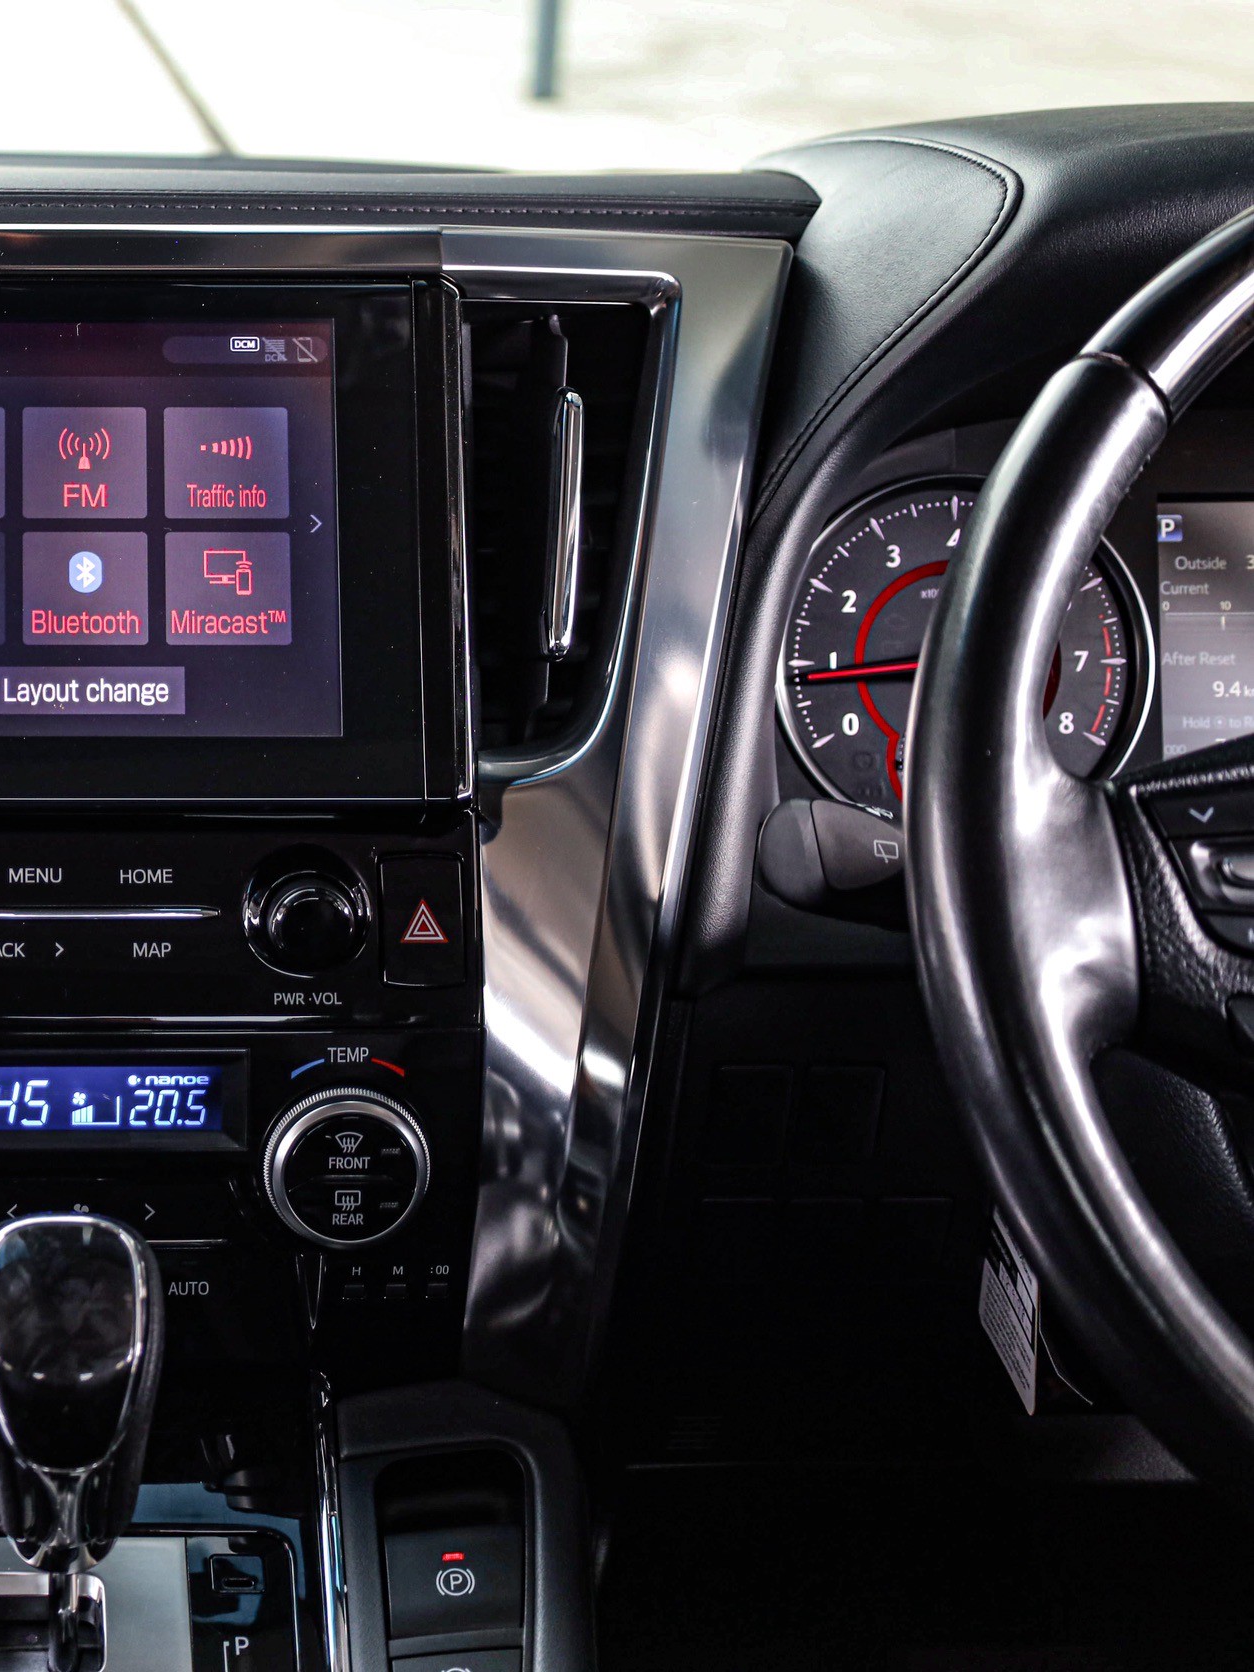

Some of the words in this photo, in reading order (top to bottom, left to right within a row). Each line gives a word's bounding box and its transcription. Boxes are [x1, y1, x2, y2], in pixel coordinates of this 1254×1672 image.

[234, 340, 256, 349] DCM
[63, 484, 108, 507] FM
[187, 484, 235, 507] Traffic
[239, 484, 267, 507] info
[1160, 518, 1176, 539] P
[886, 545, 901, 568] 3
[1175, 555, 1228, 570] Outside
[1161, 581, 1210, 595] Current
[841, 590, 857, 613] 2
[1162, 601, 1170, 611] 0
[1220, 601, 1232, 611] 10
[31, 610, 140, 635] Bluetooth
[829, 652, 838, 670] 1
[1074, 651, 1089, 672] 7
[1162, 652, 1195, 666] After
[1199, 652, 1236, 666] Reset
[3, 679, 79, 705] Layout
[86, 679, 169, 705] change
[1212, 681, 1241, 698] 9.4
[842, 712, 860, 736] 0
[1058, 712, 1075, 735] 8
[1183, 716, 1210, 728] Hold
[8, 868, 63, 884] MENU
[119, 869, 173, 884] HOME
[132, 942, 171, 959] MAP
[327, 1046, 369, 1063] TEMP
[145, 1074, 210, 1086] nanoe
[129, 1089, 207, 1126] 20.5
[328, 1157, 371, 1170] FRONT
[332, 1213, 364, 1226] REAR
[352, 1267, 361, 1276] H
[392, 1266, 404, 1275] M
[168, 1281, 210, 1296] AUTO
[235, 1636, 249, 1656] P
